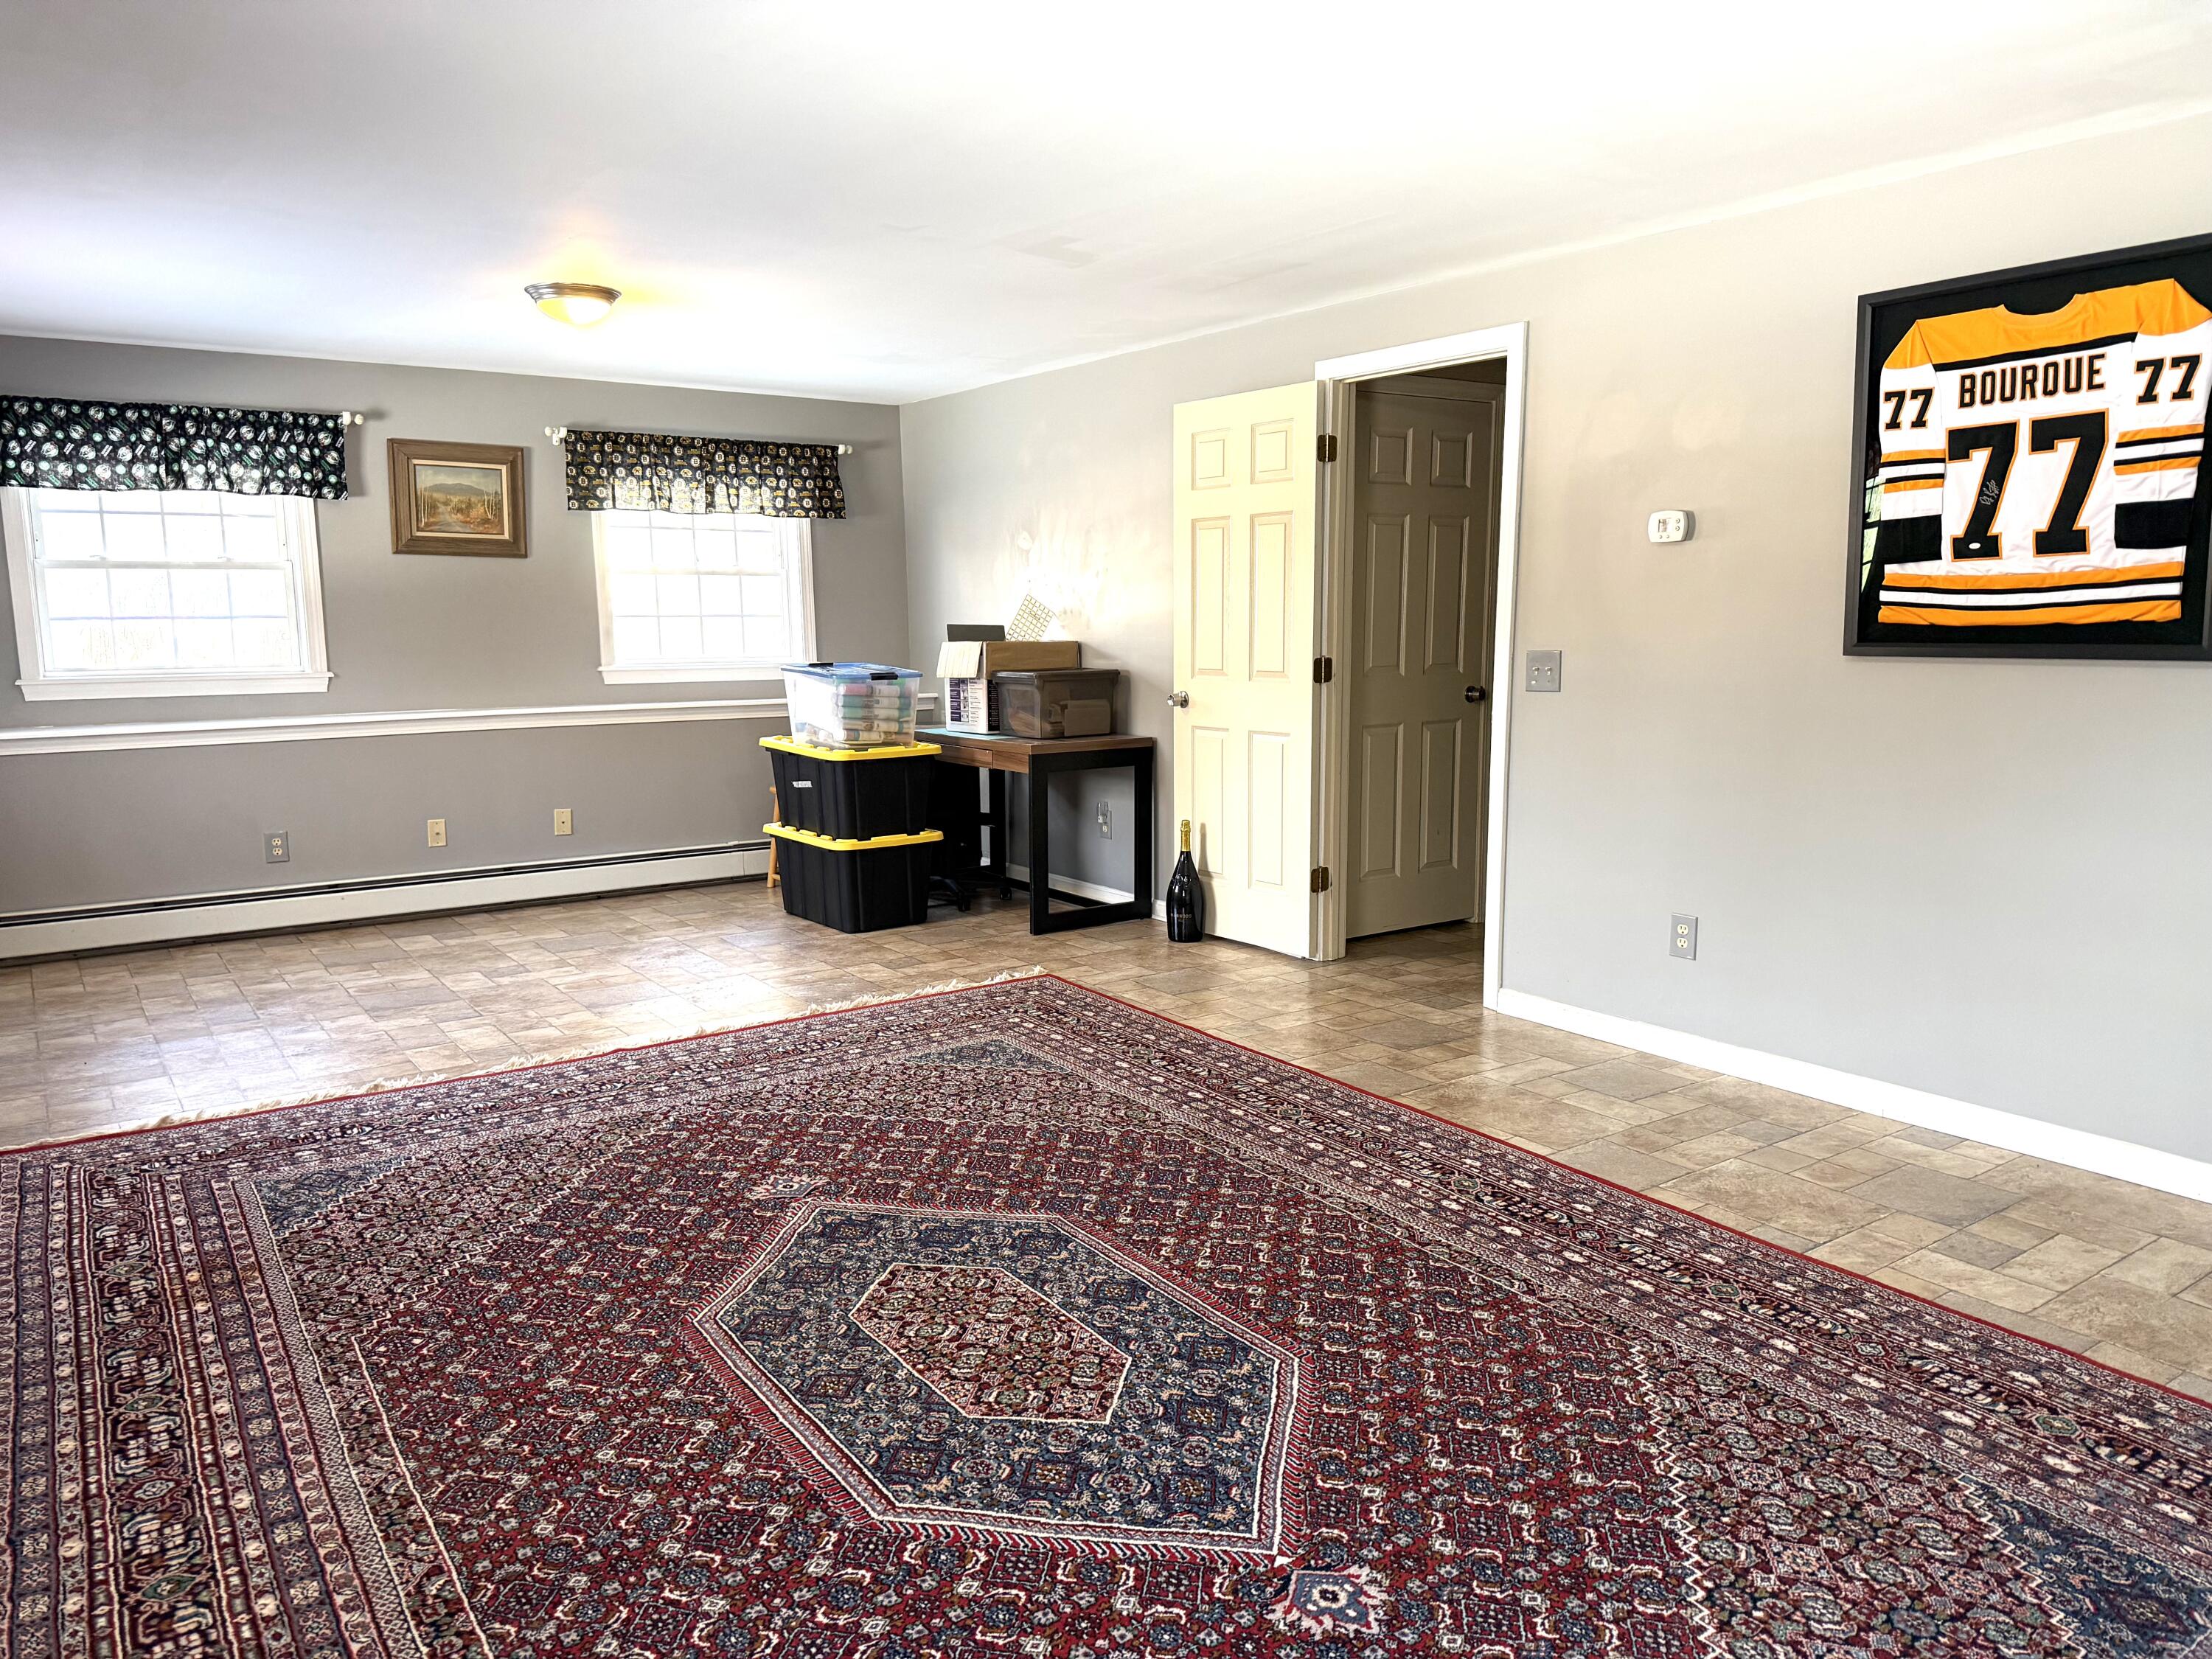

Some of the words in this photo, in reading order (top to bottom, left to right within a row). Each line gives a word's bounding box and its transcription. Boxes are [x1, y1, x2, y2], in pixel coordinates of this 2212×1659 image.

[1958, 352, 2107, 409] BOURQUE
[2135, 352, 2202, 406] 77
[1882, 387, 1935, 431] 77
[1945, 408, 2110, 562] 77
